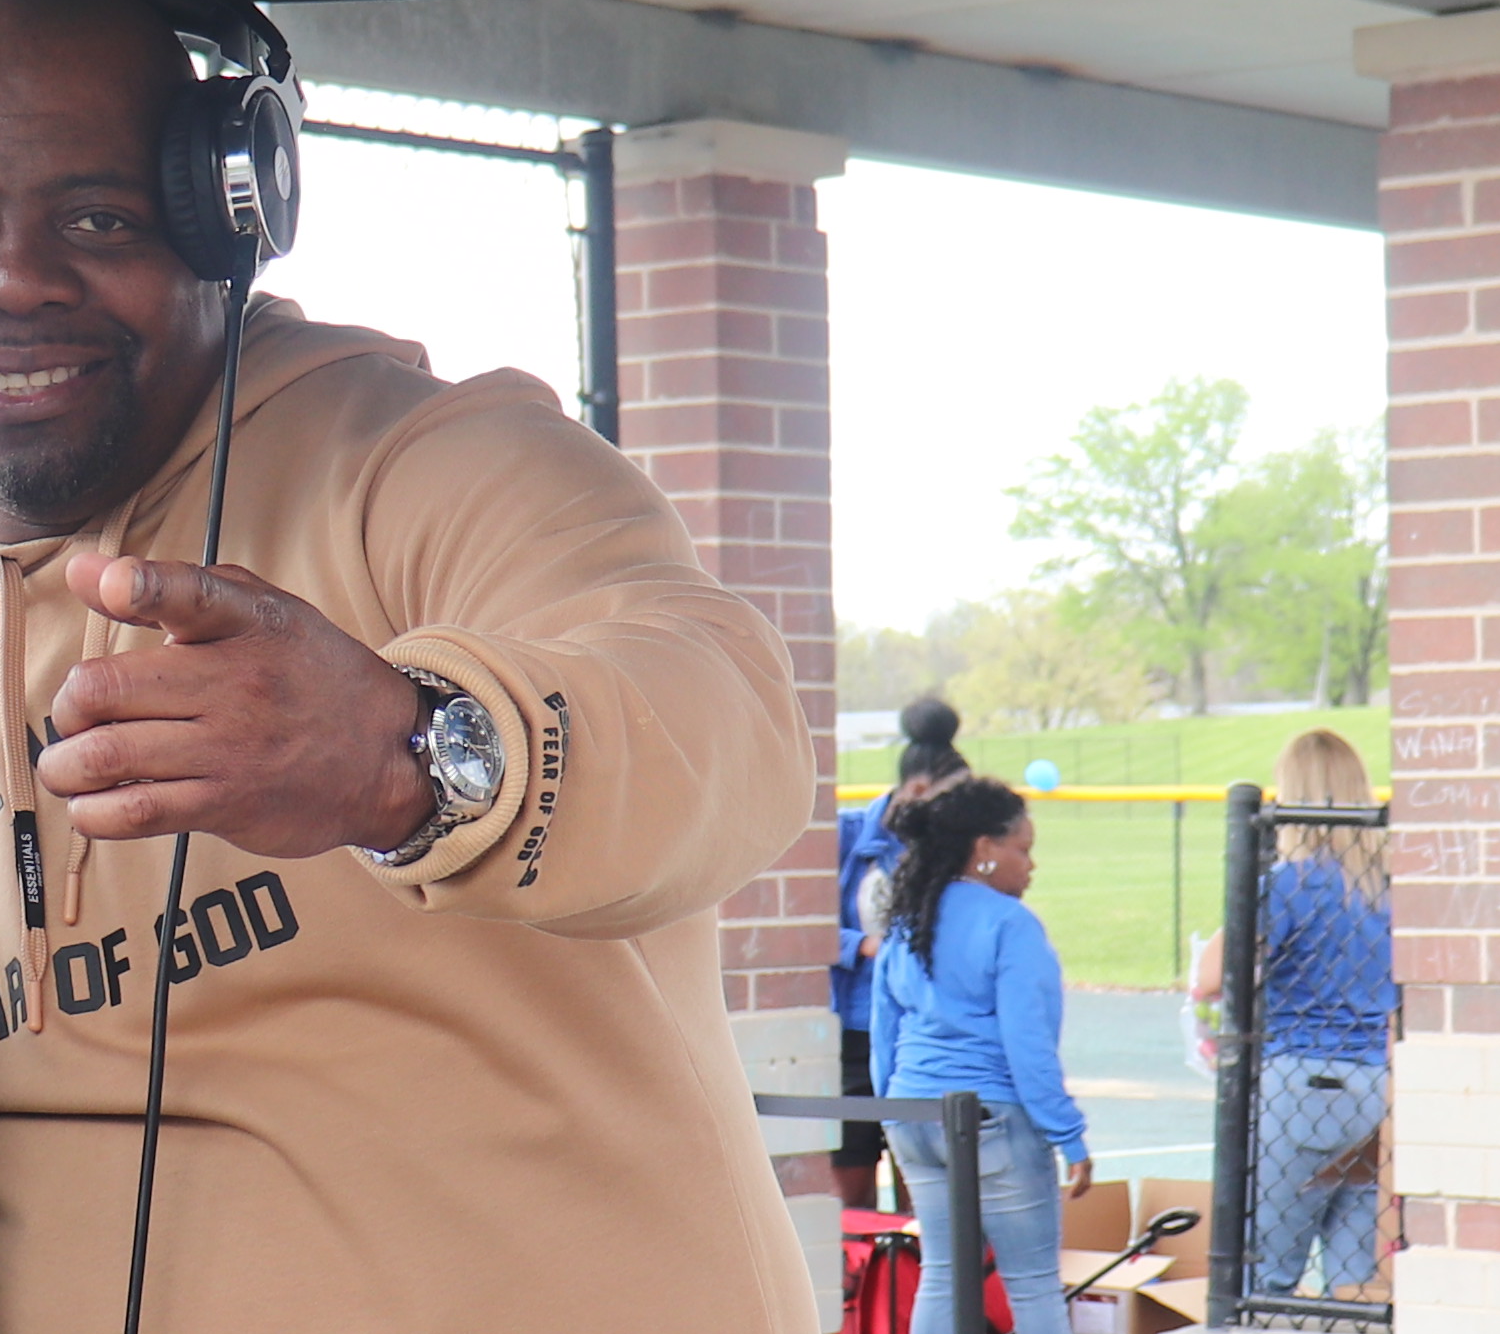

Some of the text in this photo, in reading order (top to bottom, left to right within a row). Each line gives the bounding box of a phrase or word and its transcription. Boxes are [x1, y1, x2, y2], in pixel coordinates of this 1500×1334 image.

[542, 727, 559, 780] FEAR
[538, 791, 556, 815] OF
[21, 833, 40, 904] ESSENTIALS
[52, 927, 131, 1016] OF
[154, 870, 300, 985] GOD
